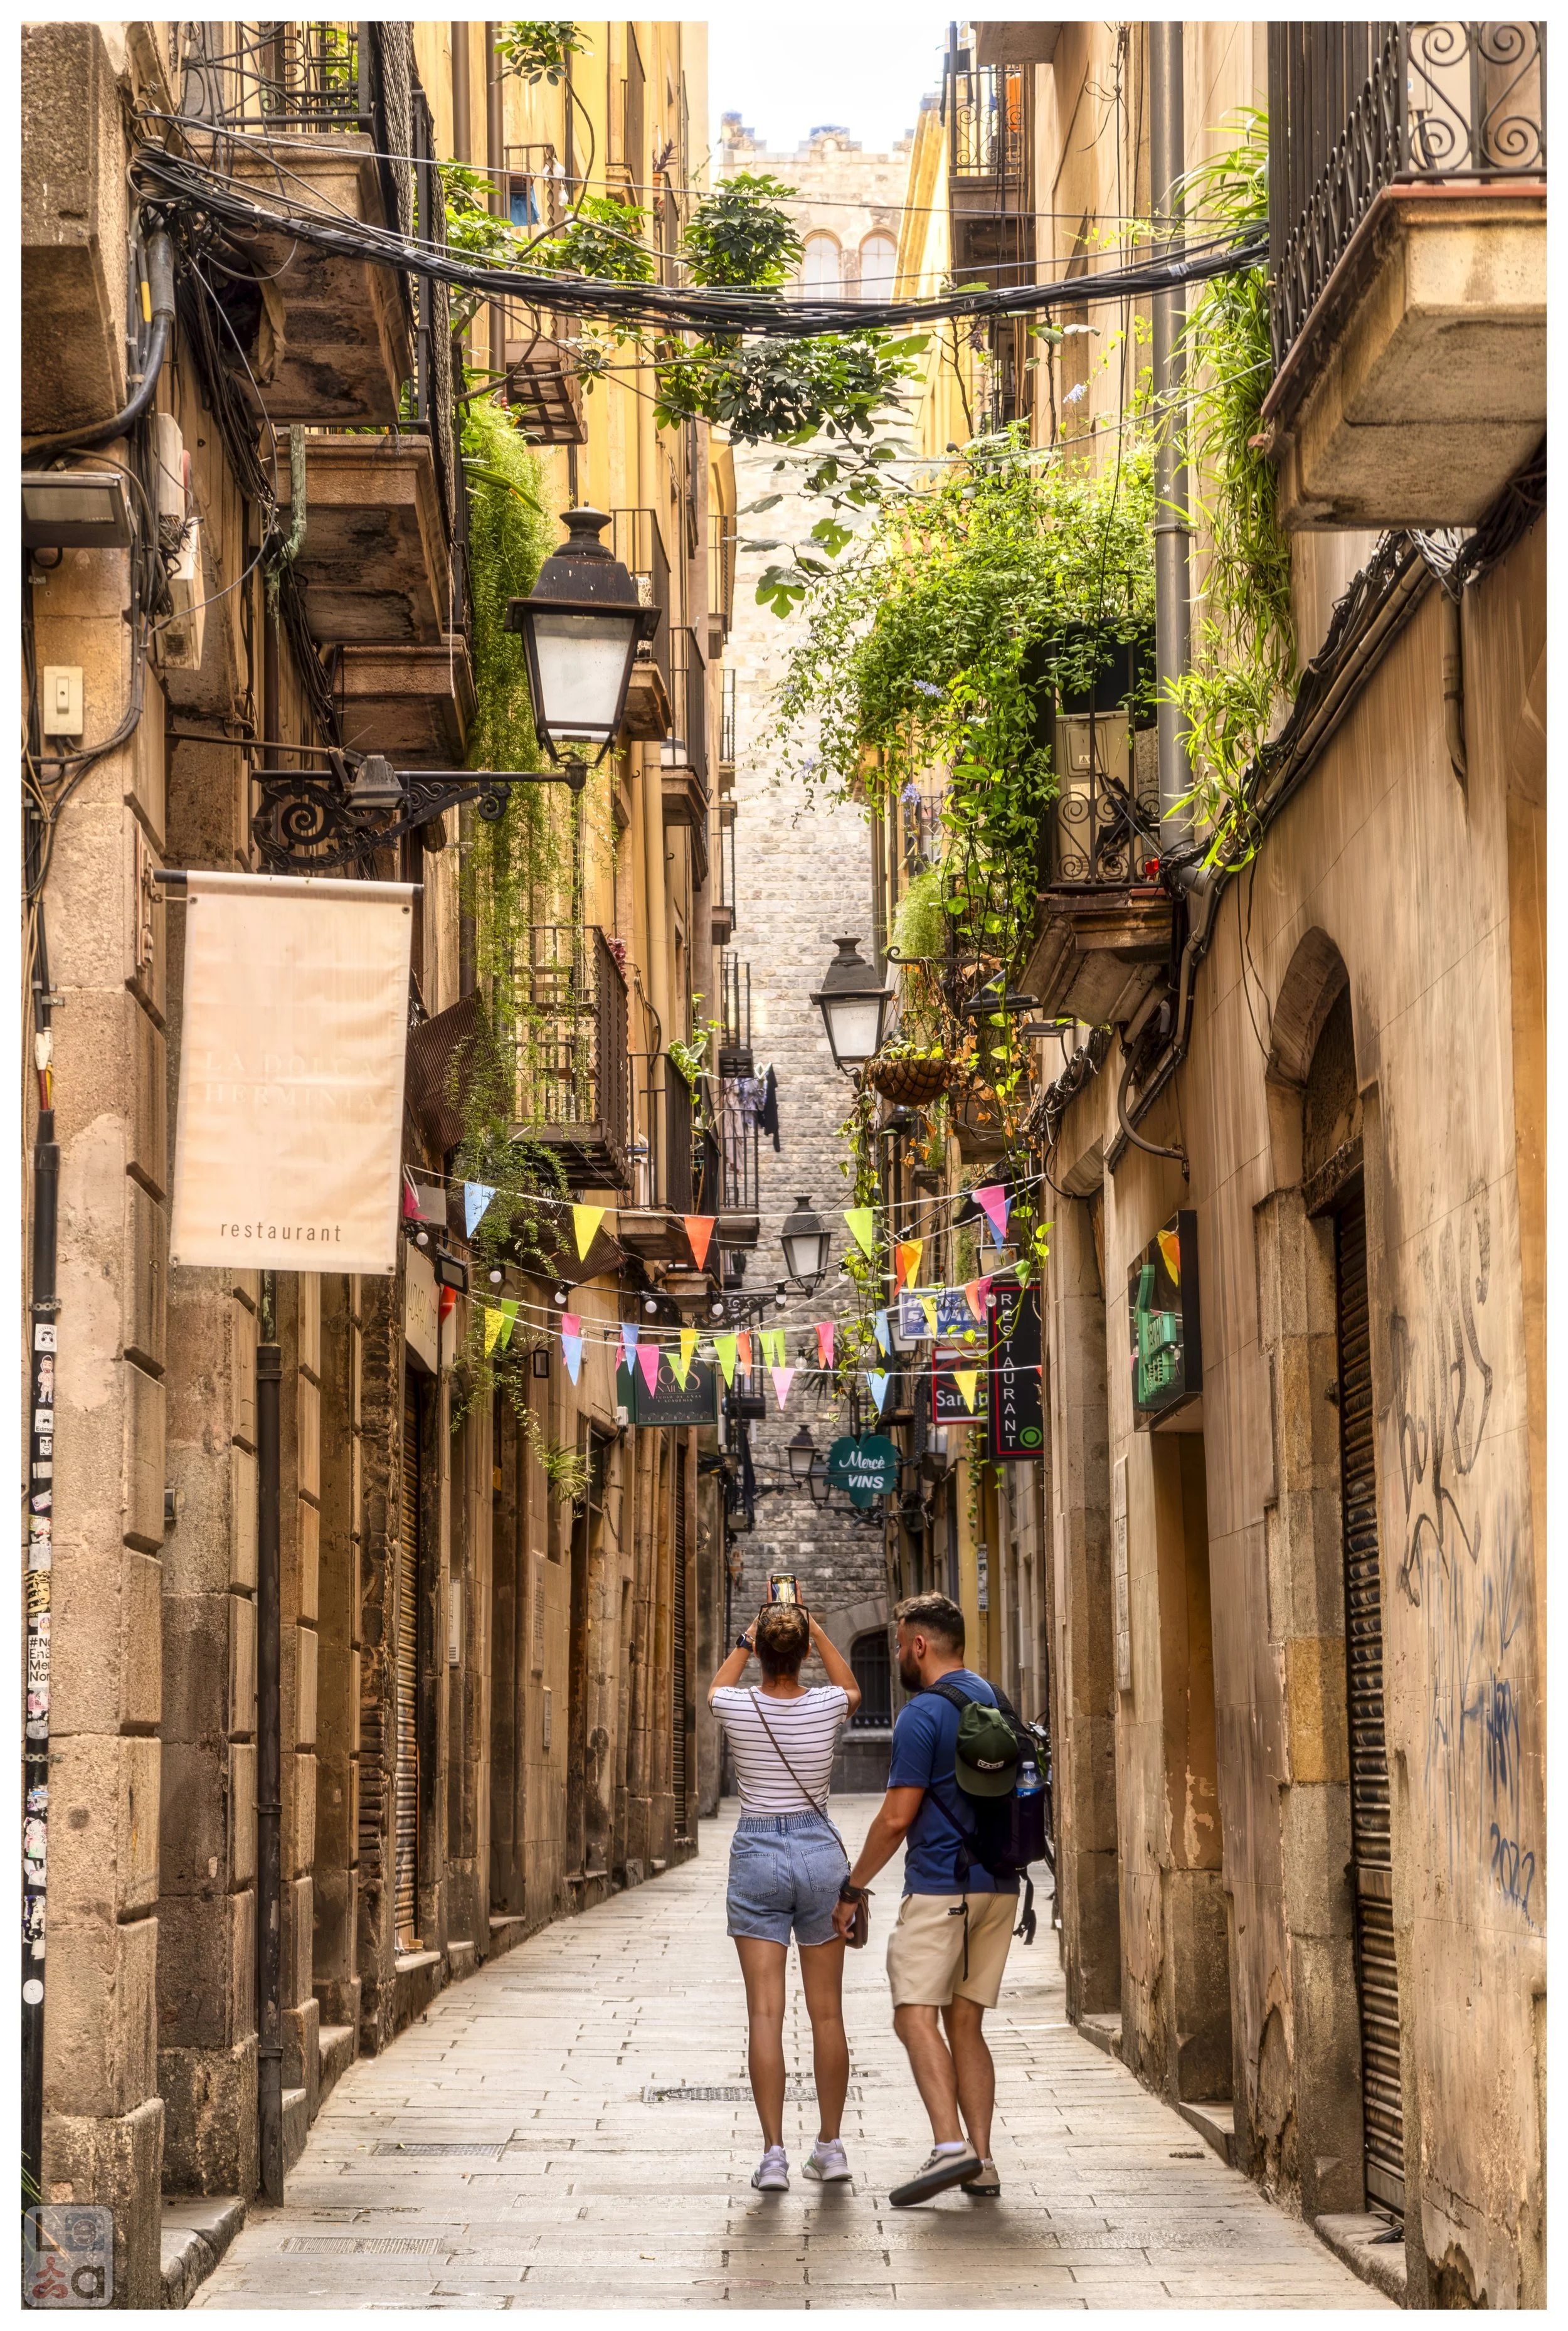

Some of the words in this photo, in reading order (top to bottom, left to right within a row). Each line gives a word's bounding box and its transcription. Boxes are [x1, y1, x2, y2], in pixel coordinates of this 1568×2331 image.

[204, 1051, 245, 1071] LA
[221, 1221, 341, 1242] restaurant
[1001, 1293, 1016, 1447] RESTAURANT
[839, 1450, 886, 1469] Mercè
[848, 1474, 884, 1489] VINS
